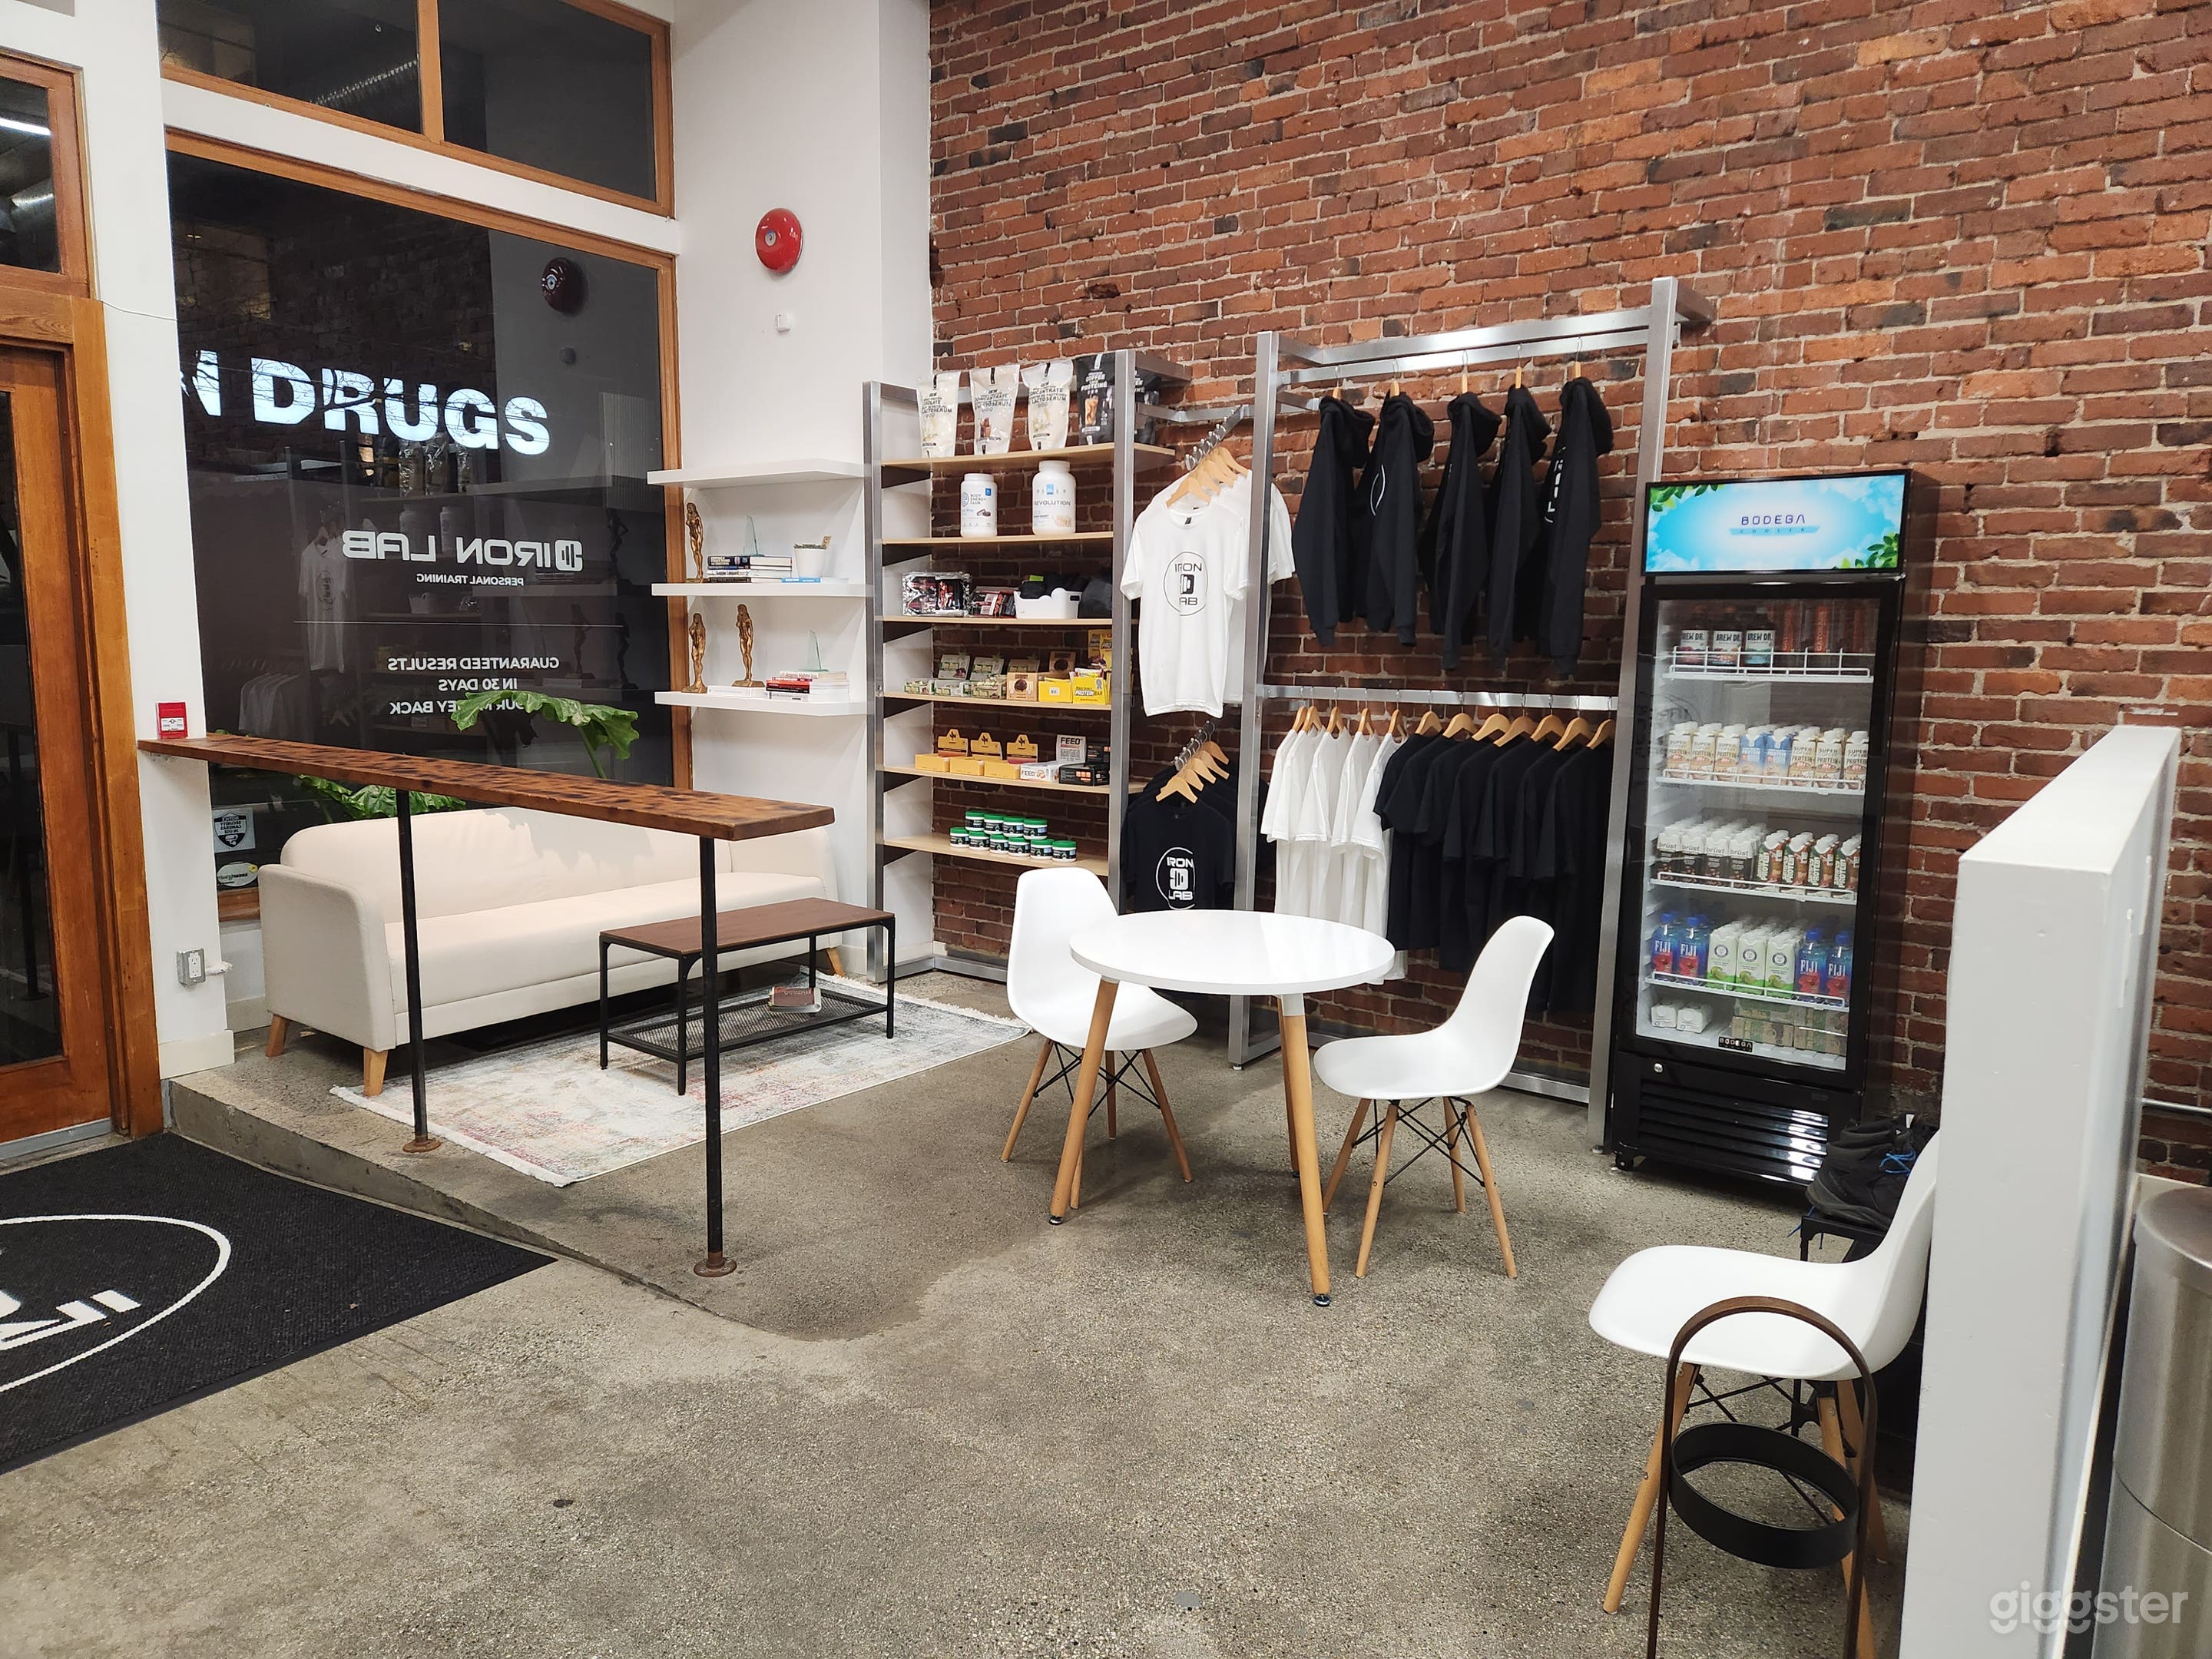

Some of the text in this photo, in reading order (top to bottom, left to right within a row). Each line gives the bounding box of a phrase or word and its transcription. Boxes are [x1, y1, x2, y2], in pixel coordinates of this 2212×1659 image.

[250, 356, 551, 455] DRUGS
[1741, 514, 1806, 525] BODEGA
[1174, 563, 1203, 571] IRON
[1180, 597, 1198, 605] AB
[1167, 856, 1193, 868] IRON
[1168, 889, 1193, 900] LAB
[1654, 940, 1671, 952] FIJI
[1680, 943, 1697, 956] FIJI
[1800, 959, 1818, 972] FIJI
[1829, 963, 1846, 976] FIJI
